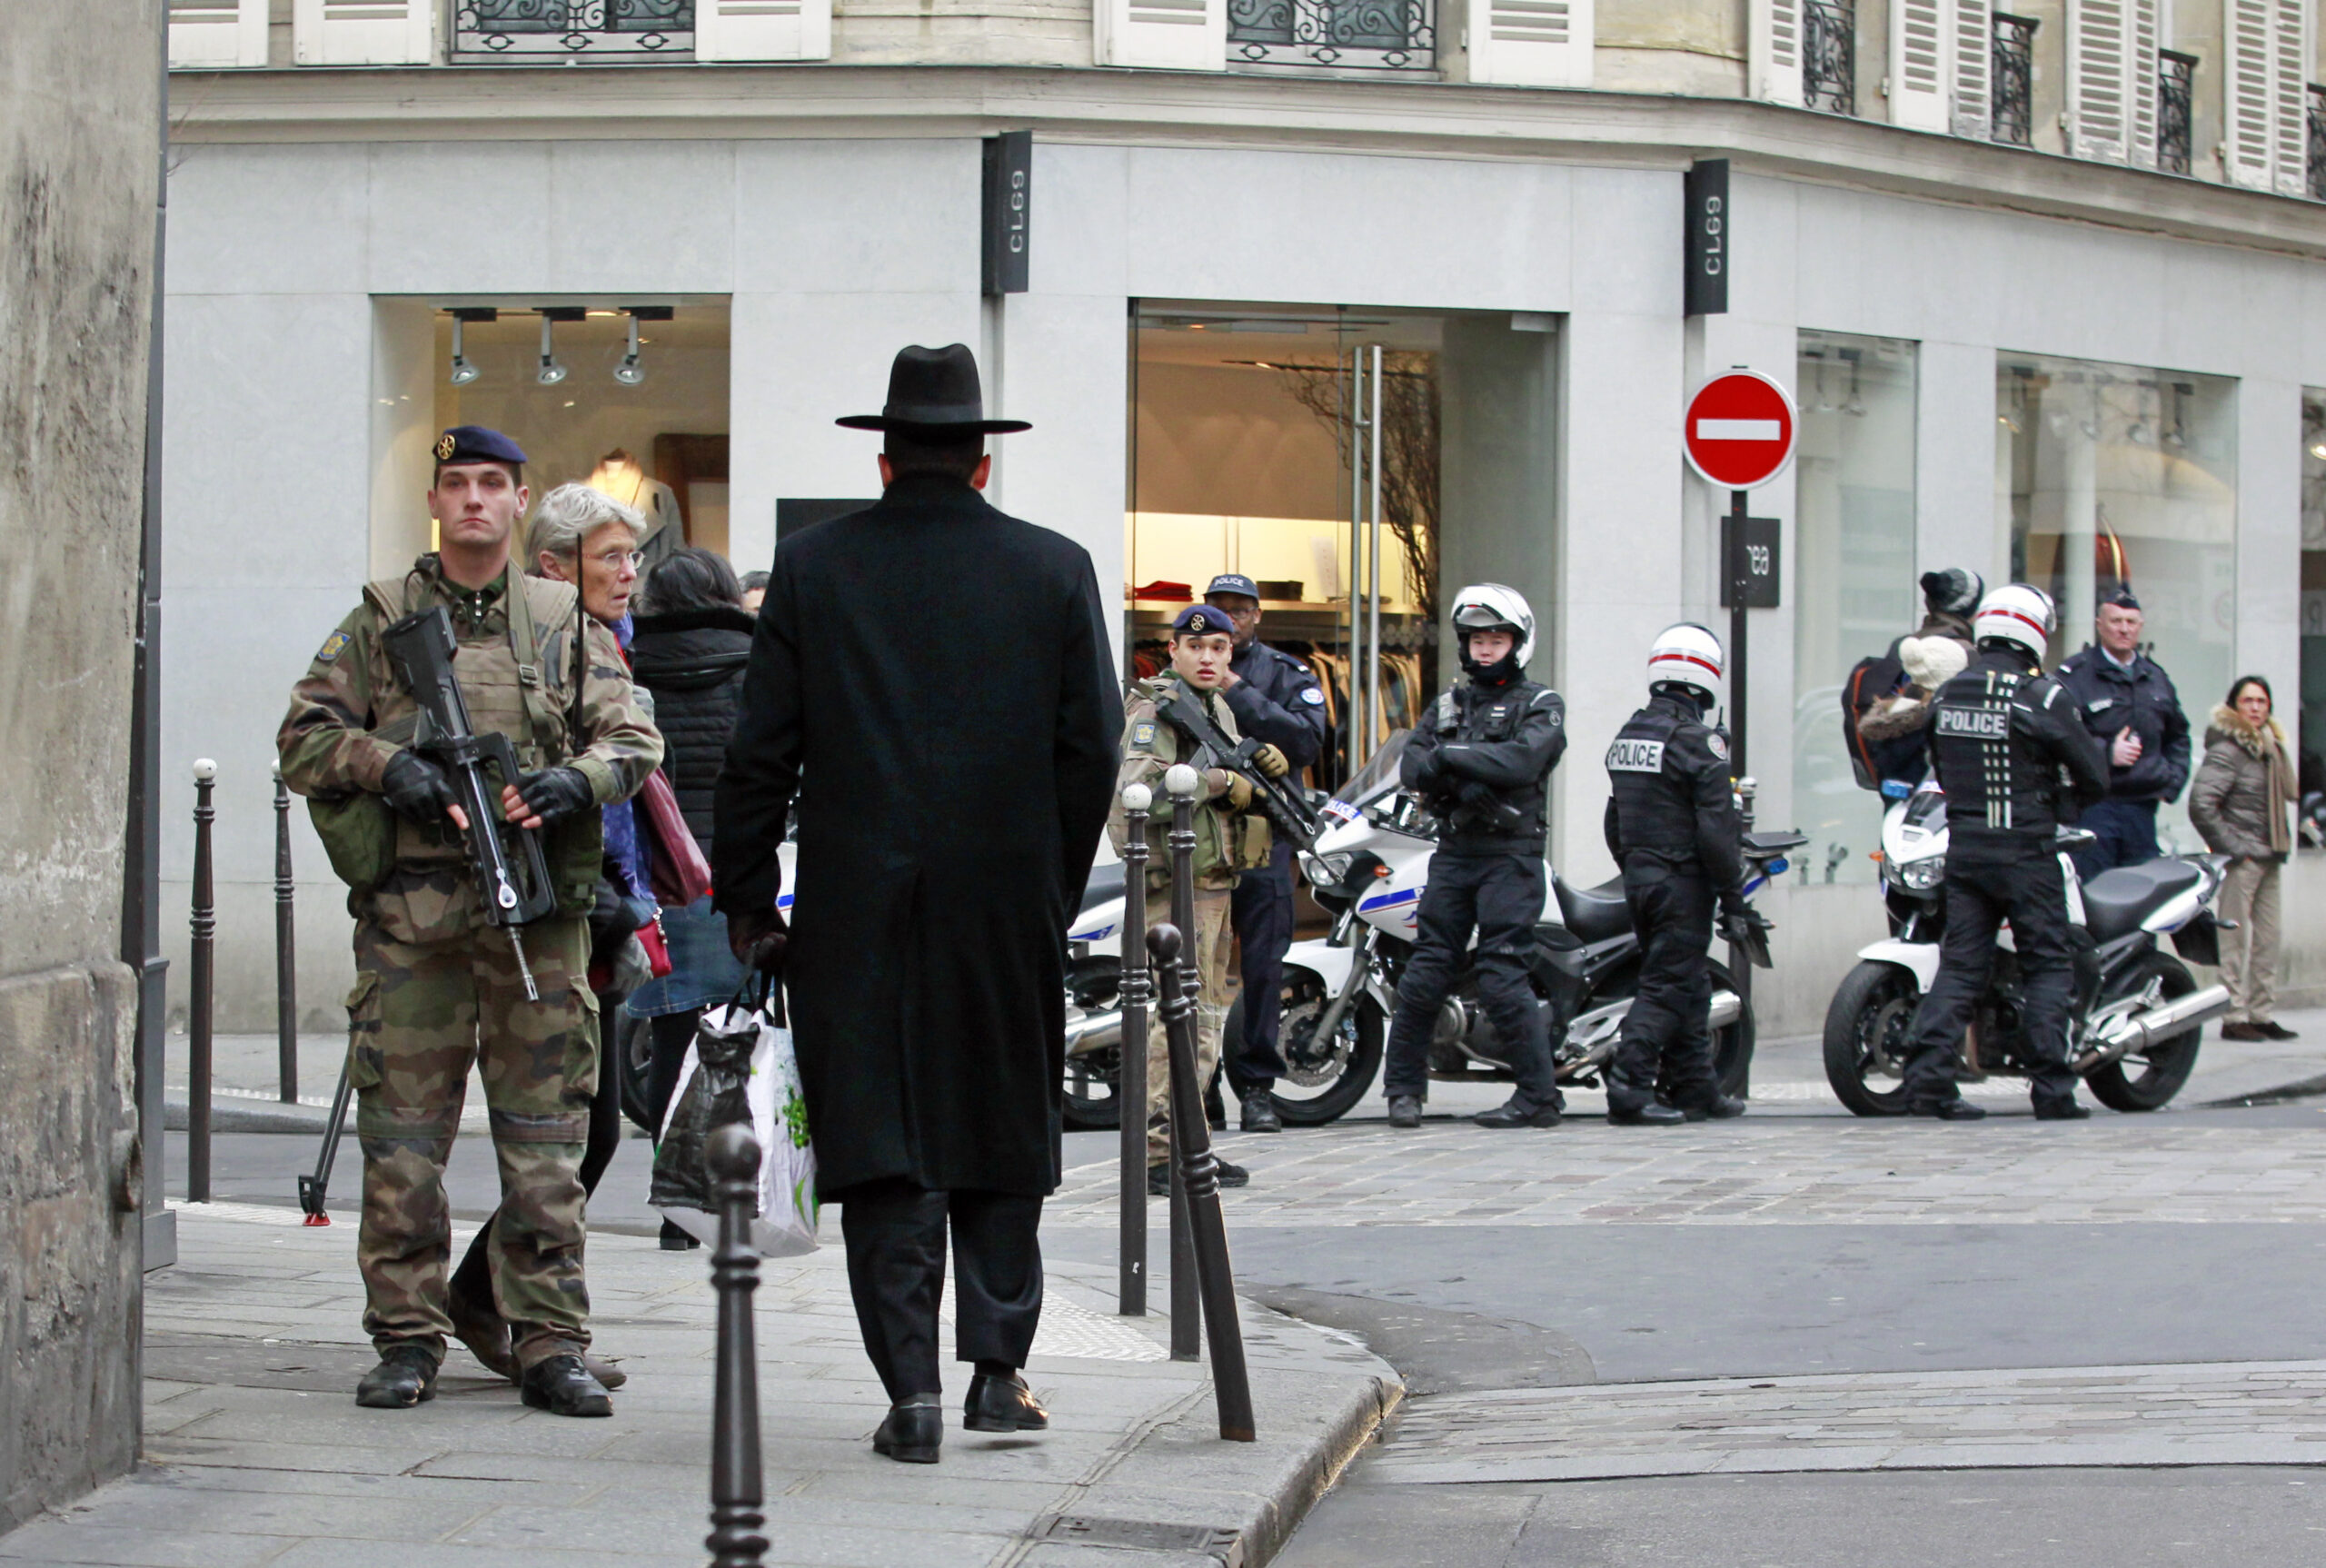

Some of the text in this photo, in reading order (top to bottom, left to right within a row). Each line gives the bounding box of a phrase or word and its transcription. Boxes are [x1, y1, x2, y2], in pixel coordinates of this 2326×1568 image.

[1009, 170, 1025, 253] CL69
[1705, 195, 1723, 275] CL69
[1214, 577, 1244, 588] POLICE
[1939, 710, 2007, 735] POLICE
[1609, 744, 1658, 767] POLICE
